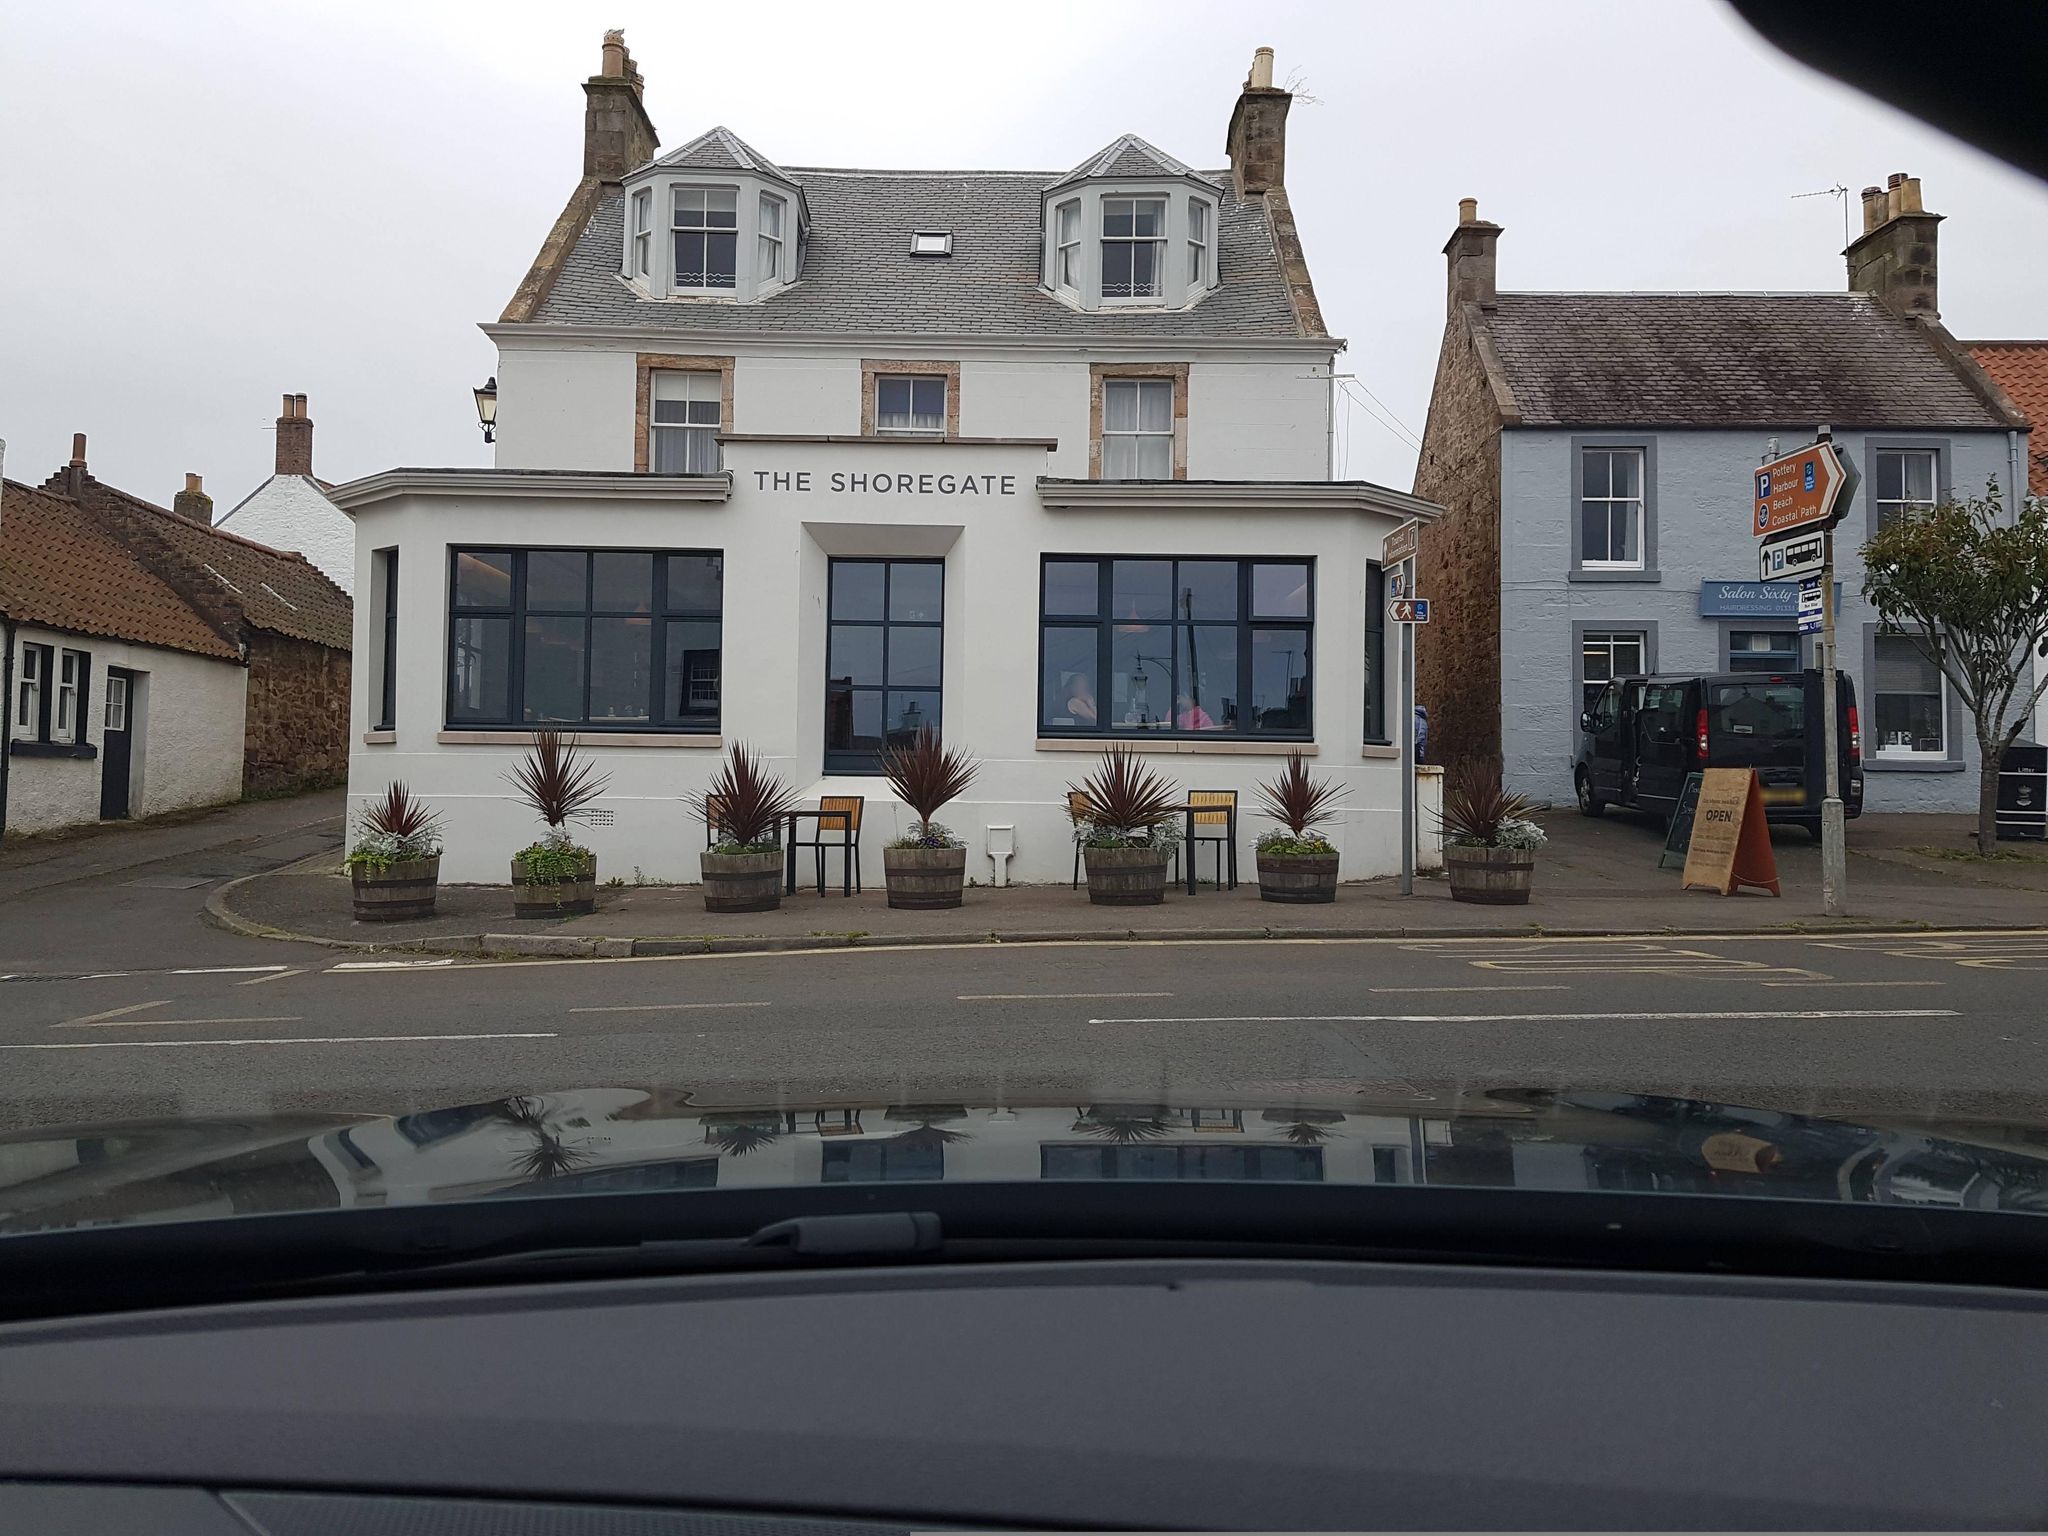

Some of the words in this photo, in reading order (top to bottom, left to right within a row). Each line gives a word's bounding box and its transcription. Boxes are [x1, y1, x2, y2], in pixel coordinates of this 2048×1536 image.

[1772, 463, 1797, 478] Pottery
[753, 471, 812, 492] THE
[830, 472, 1016, 495] SHOREGATE
[1760, 475, 1769, 497] P
[1773, 479, 1798, 494] Harbour
[1773, 496, 1793, 511] Beach
[1772, 510, 1798, 526] Coastal
[1800, 505, 1817, 518] Path
[1774, 551, 1782, 569] P
[1718, 585, 1757, 600] Salon
[1760, 585, 1799, 604] Sixty-
[1706, 810, 1733, 823] OPEN
[1398, 943, 1834, 981] STOP
